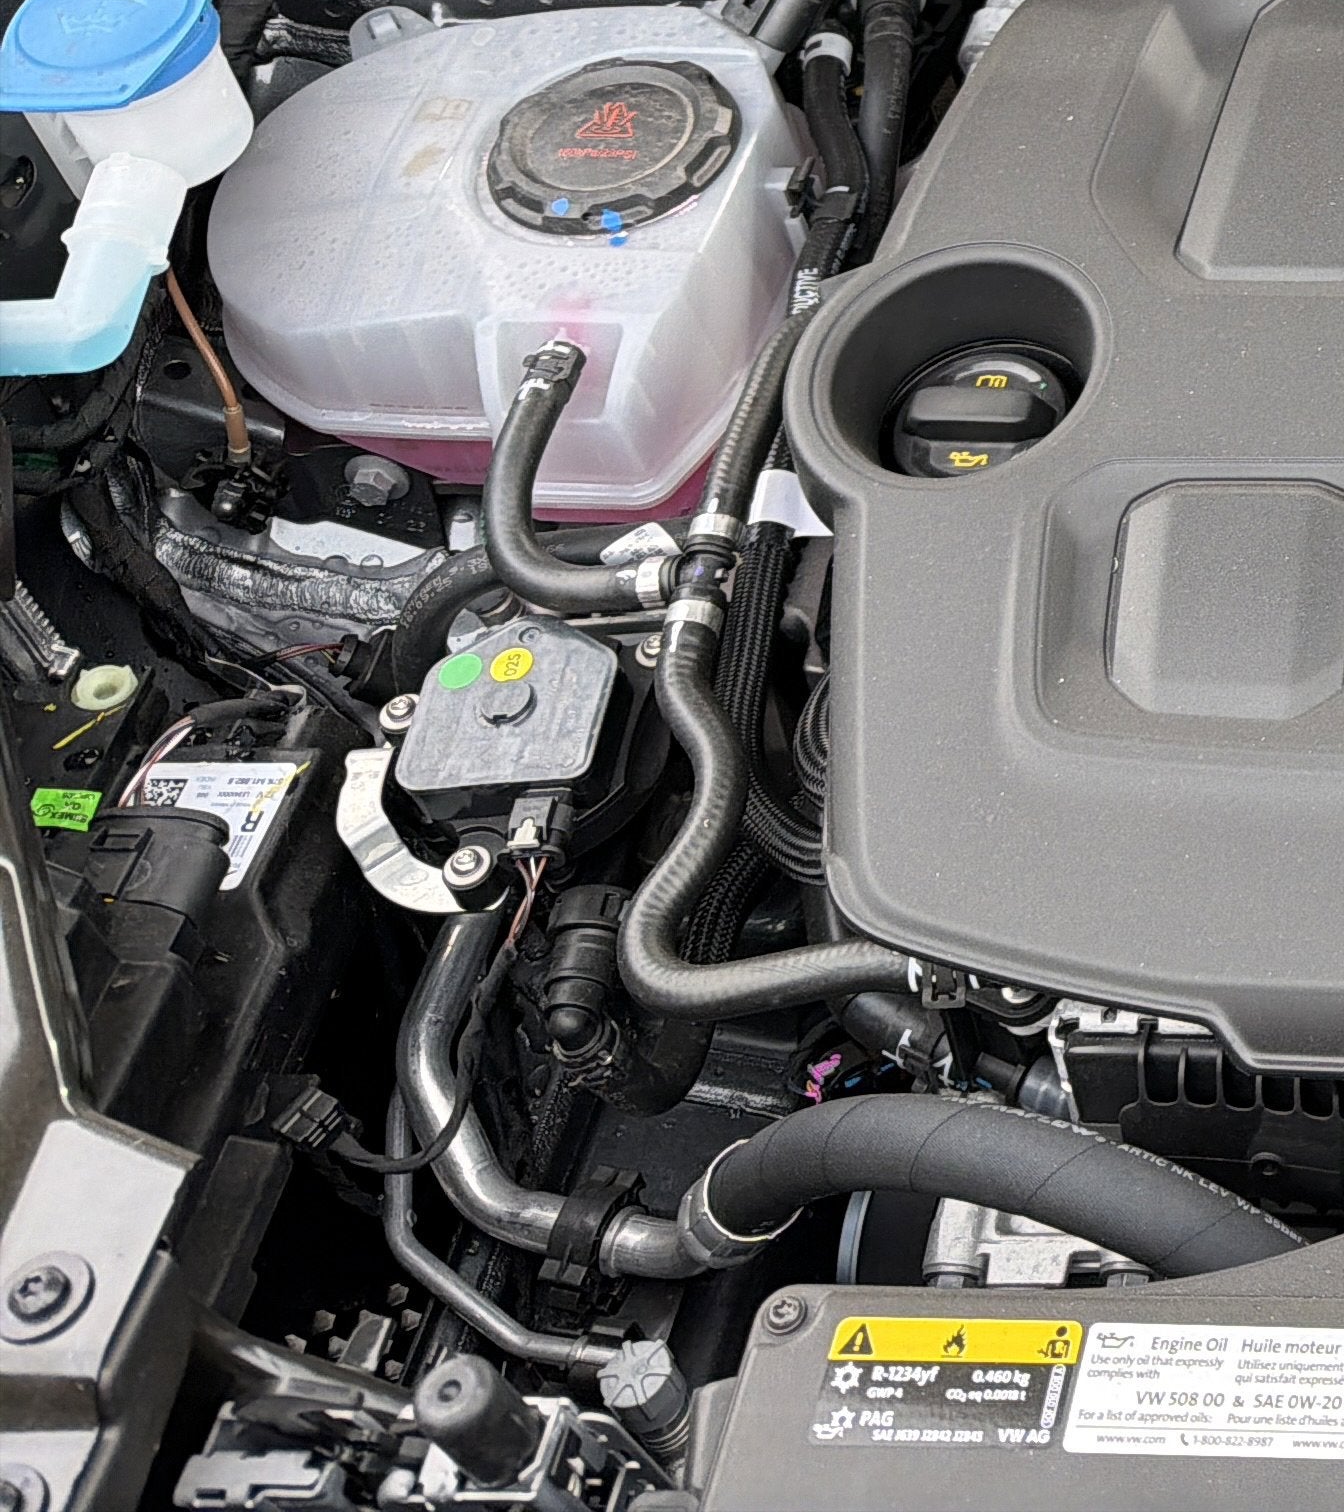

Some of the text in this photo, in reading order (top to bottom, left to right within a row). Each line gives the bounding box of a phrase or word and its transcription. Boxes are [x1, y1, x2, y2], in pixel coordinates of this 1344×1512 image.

[1150, 1336, 1342, 1355] Engine Oil Huile moteur
[1091, 1354, 1224, 1370] Use only oil that expressly
[1237, 1359, 1277, 1370] Utilisez
[1279, 1361, 1344, 1373] uniquement
[871, 1366, 940, 1384] R-1234yf
[971, 1369, 1031, 1387] 0.460 kg
[1087, 1369, 1160, 1381] complies with
[1234, 1374, 1252, 1386] qui
[1254, 1373, 1296, 1384] satisfait
[866, 1388, 893, 1399] GWP
[967, 1390, 982, 1403] eq
[1136, 1390, 1343, 1409] VW 508 00 & SAE 0W-20
[858, 1410, 894, 1426] PAG
[1078, 1409, 1095, 1421] For
[1106, 1409, 1121, 1421] list
[1124, 1410, 1138, 1422] of
[1137, 1411, 1188, 1424] approved
[1227, 1414, 1338, 1427] Pour une liste d'huiles
[871, 1428, 1051, 1443] SAE VW AG
[1096, 1435, 1167, 1444] www.vw.com
[1193, 1435, 1274, 1447] 1-800-822-8987
